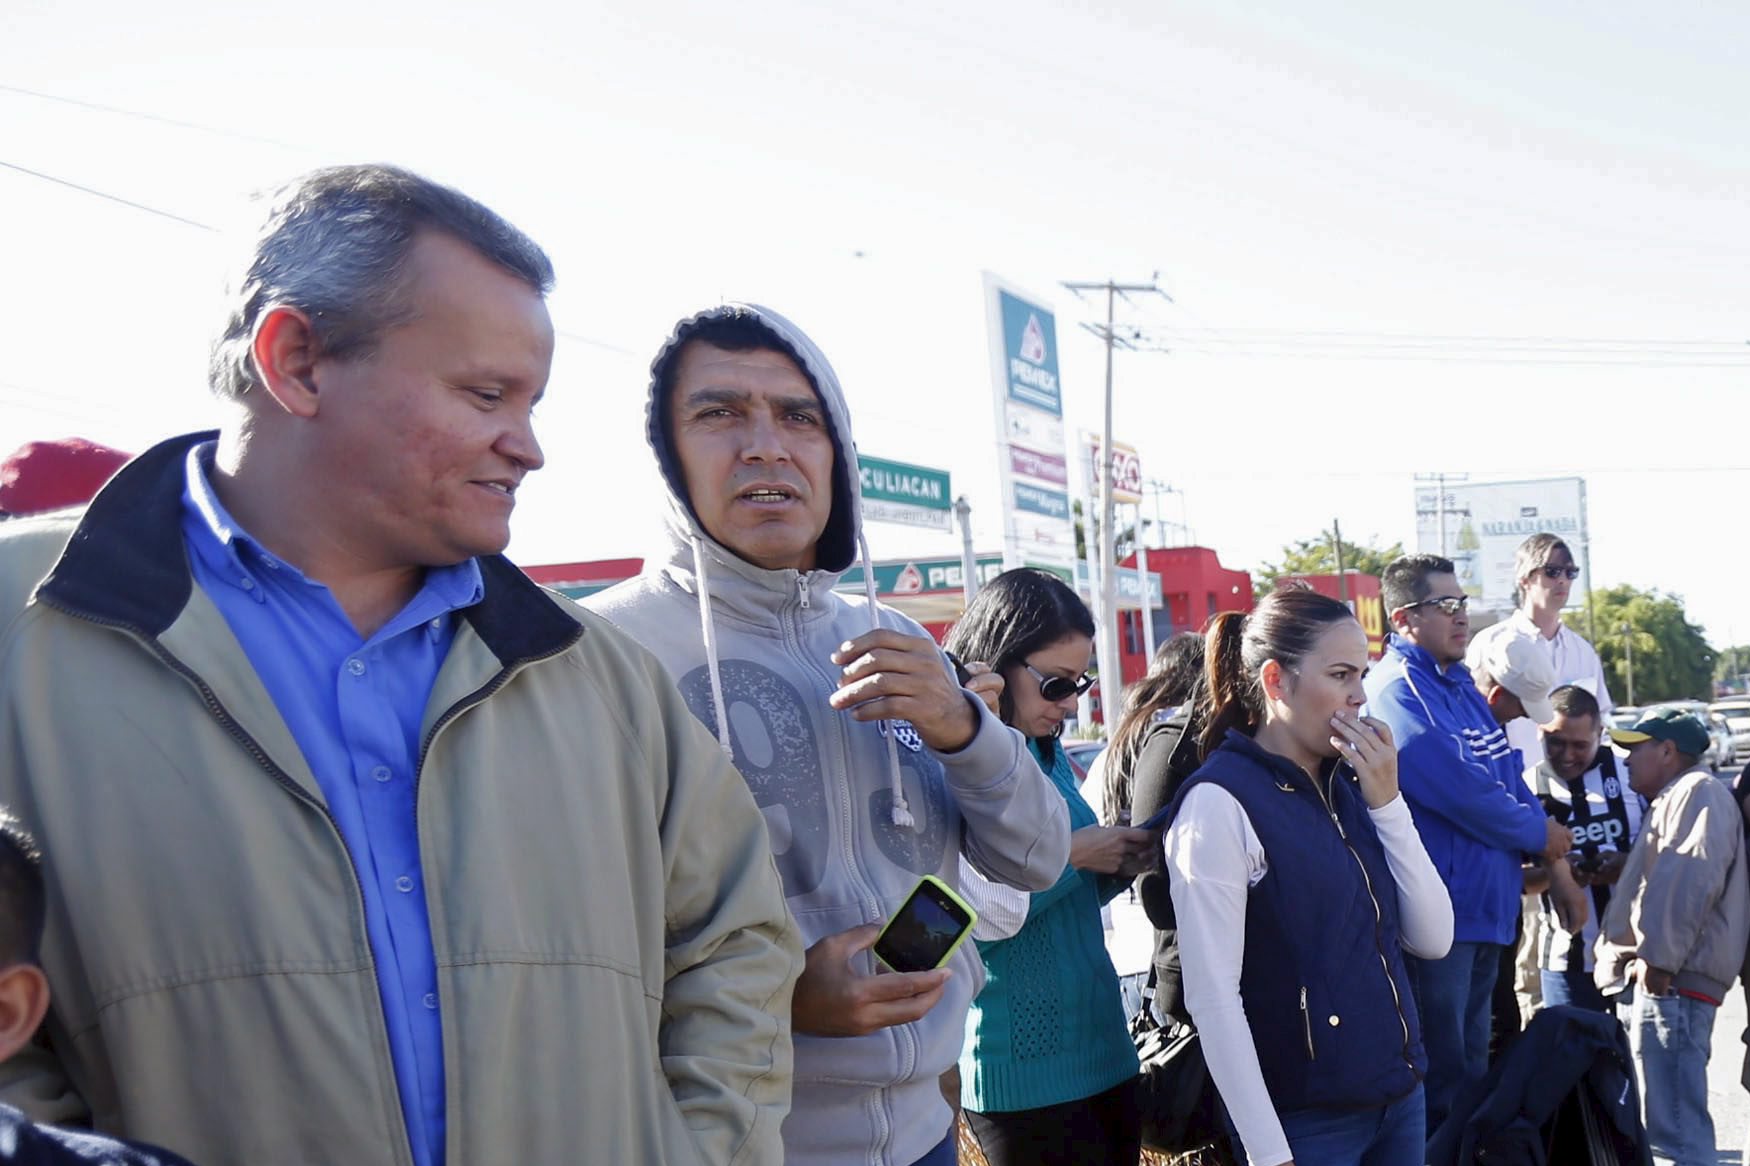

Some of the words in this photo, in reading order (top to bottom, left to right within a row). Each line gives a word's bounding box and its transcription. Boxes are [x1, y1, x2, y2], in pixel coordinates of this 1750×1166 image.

[1010, 358, 1057, 393] PEMEX
[860, 467, 942, 499] CULIACAN
[1571, 818, 1623, 846] eep
